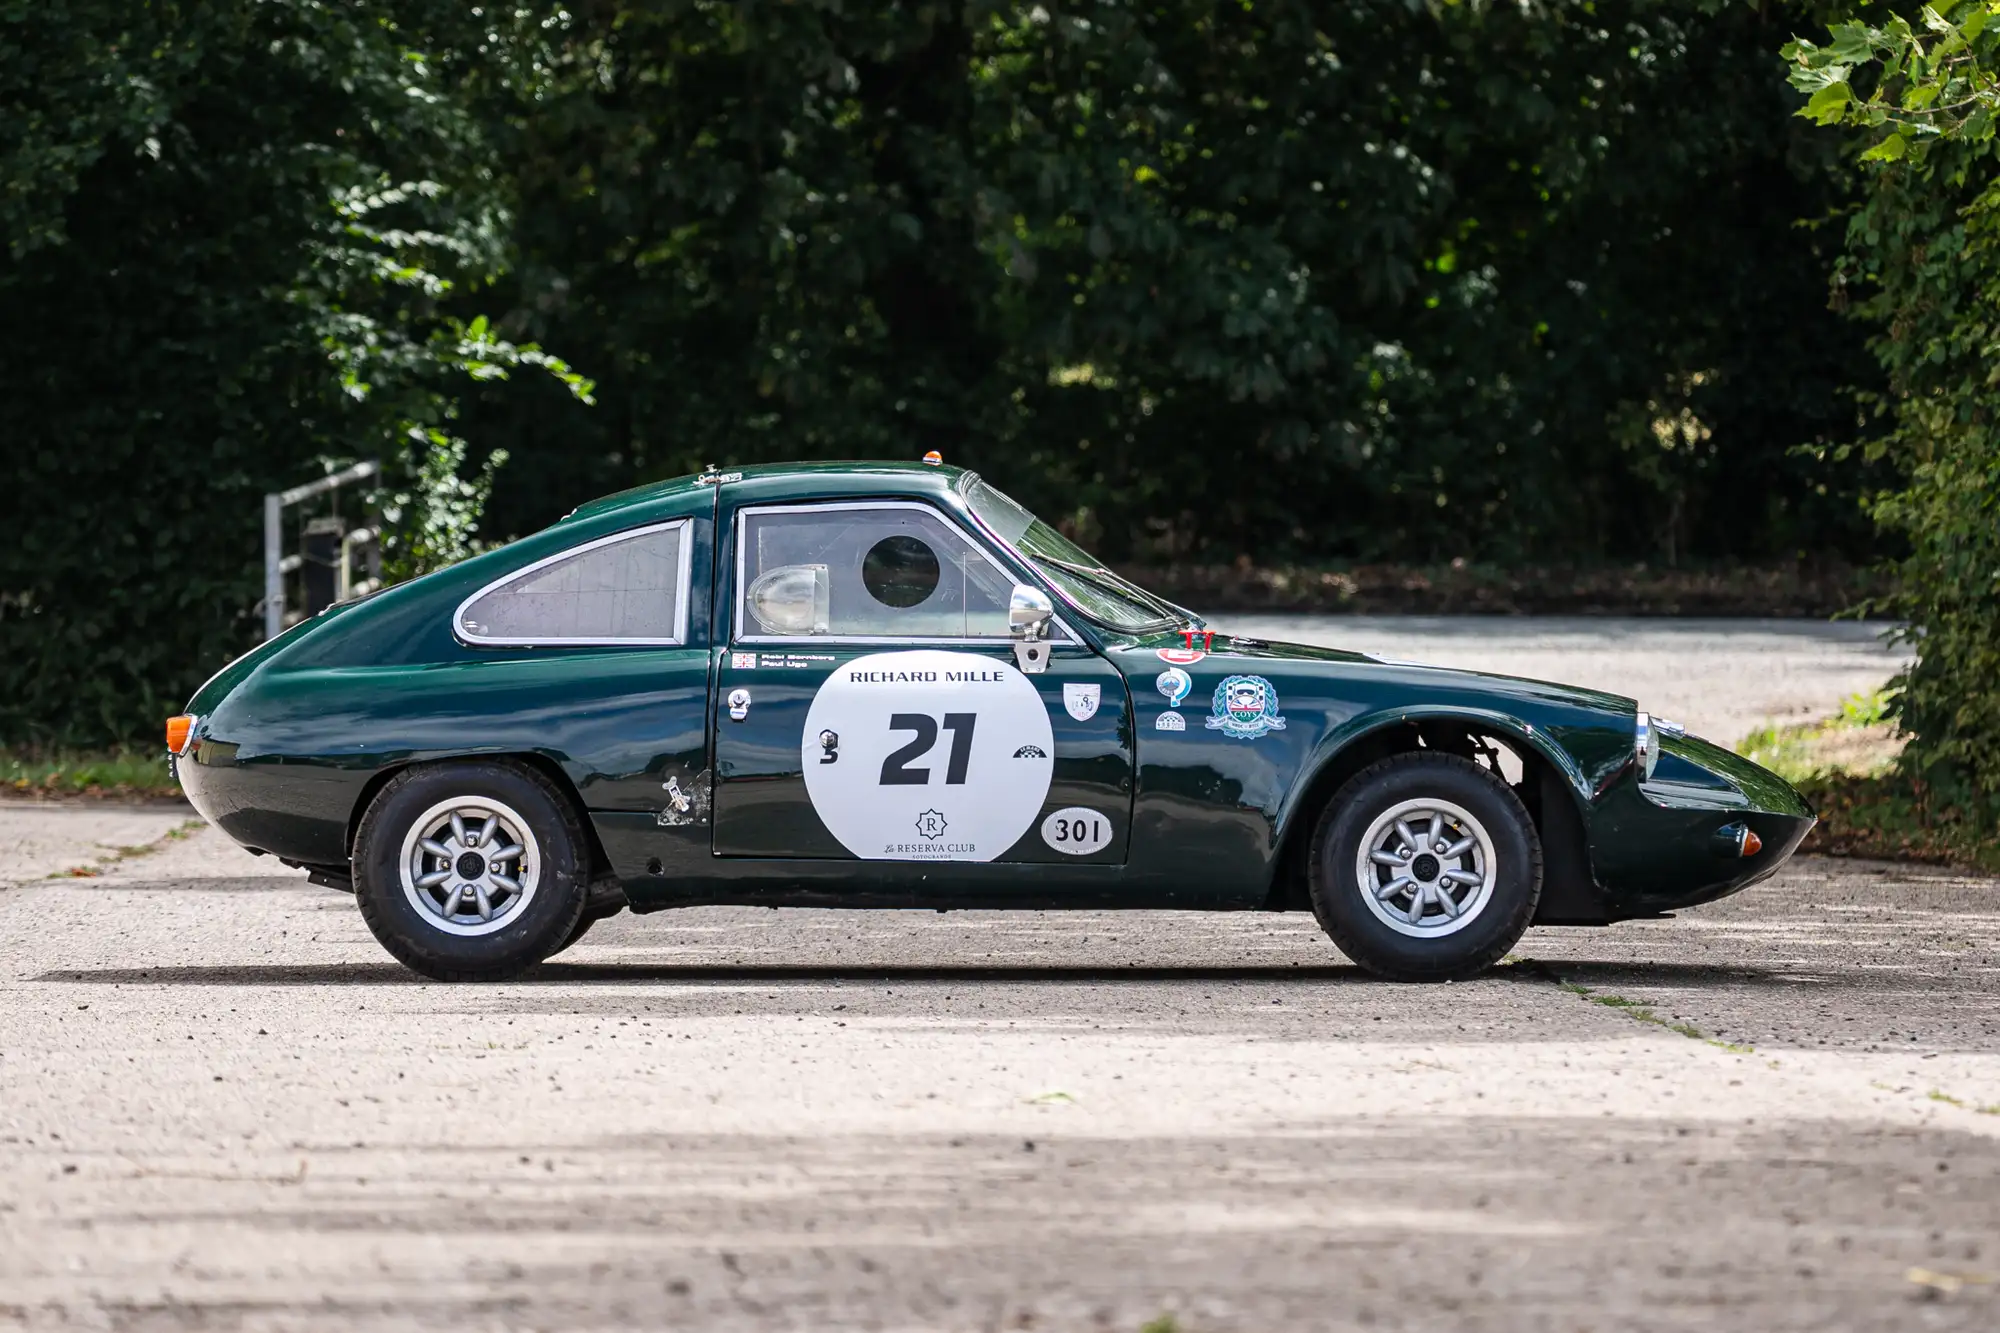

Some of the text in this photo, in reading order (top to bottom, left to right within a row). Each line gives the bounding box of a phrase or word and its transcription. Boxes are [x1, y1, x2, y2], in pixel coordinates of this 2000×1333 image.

[850, 671, 1004, 683] RICHARD MILLE
[879, 713, 977, 785] 21
[926, 817, 937, 831] R
[1055, 819, 1099, 842] 301
[897, 844, 945, 853] RESERVA
[947, 843, 976, 853] CLUB
